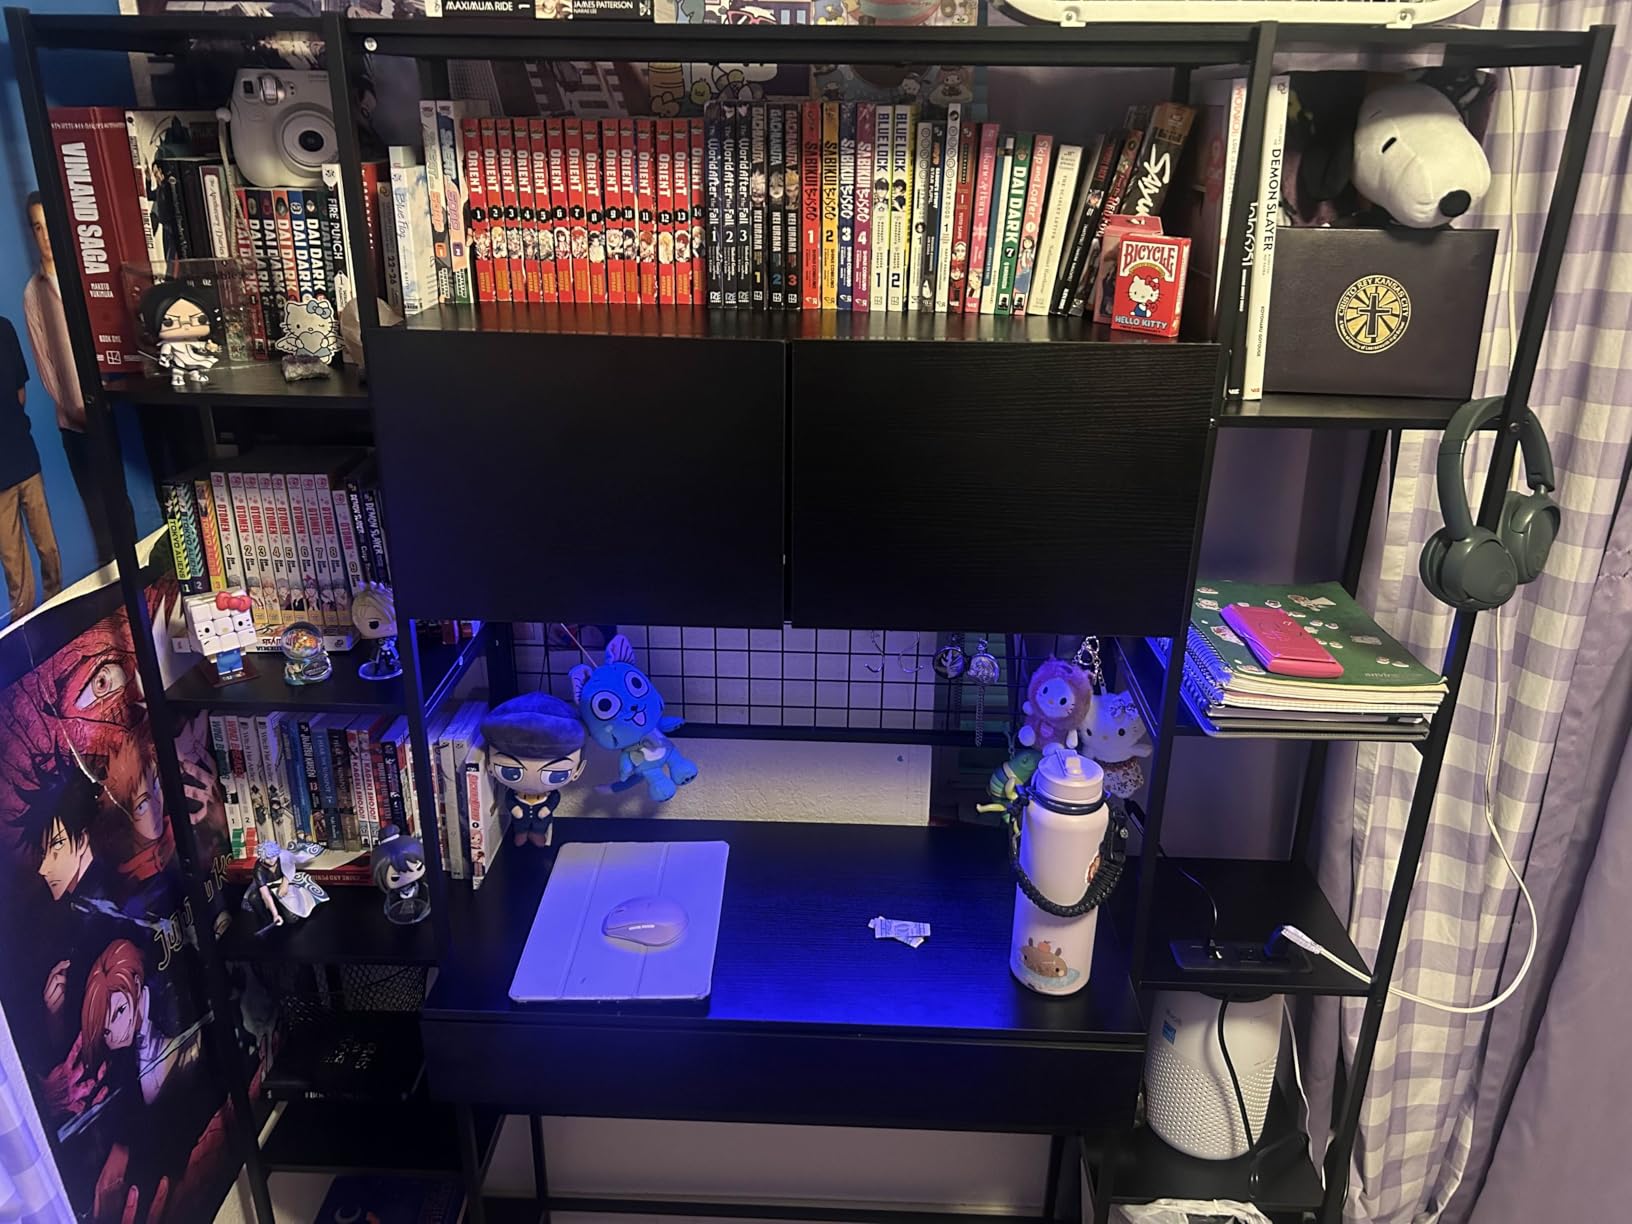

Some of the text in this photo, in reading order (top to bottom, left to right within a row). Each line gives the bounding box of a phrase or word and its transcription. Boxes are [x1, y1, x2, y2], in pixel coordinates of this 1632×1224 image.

[446, 1, 494, 11] MAXIMUM
[494, 1, 513, 10] RIDE
[574, 1, 633, 9] JAMES PATTERSON
[708, 138, 721, 169] World
[724, 139, 735, 170] World
[739, 138, 750, 169] World
[804, 141, 818, 187] SABIKUI
[823, 141, 837, 186] SABIKUI
[840, 138, 855, 185] SABIKUI
[856, 141, 871, 188] SABIKUI
[1028, 140, 1048, 218] Skip and Loafer
[61, 142, 99, 221] VINLAND
[467, 150, 482, 219] ORIENT 1
[484, 149, 499, 218] ORIENT 2
[500, 149, 515, 218] ORIENT 3
[516, 150, 530, 219] ORIENT 4
[533, 152, 547, 220] ORIENT 5
[550, 149, 564, 218] ORIENT 6
[568, 149, 582, 218] ORIENT 7
[585, 153, 599, 222] ORIENT 8
[605, 149, 618, 218] ORIENT 9
[620, 149, 633, 218] ORIENT 10
[638, 152, 650, 221] ORIENT 11
[658, 153, 670, 222] ORIENT 12
[674, 152, 687, 221] ORIENT 13
[690, 148, 703, 217] ORIENT 14
[875, 113, 892, 288] BLUE LOCK 1
[891, 113, 908, 288] BLUE LOCK 2
[1010, 166, 1027, 195] DAI
[1055, 189, 1064, 215] SCARLET
[1263, 149, 1282, 252] DEMON SLAYER
[209, 188, 225, 255] Apothecary Diaries
[249, 219, 262, 246] DAI
[263, 219, 276, 246] DAI
[327, 198, 343, 259] FIRE PUNCH
[446, 190, 461, 231] SOAP
[708, 207, 719, 225] Fall
[711, 230, 718, 242] 1
[724, 208, 736, 226] Fall
[739, 207, 750, 225] Fall
[739, 229, 747, 242] 3
[825, 230, 834, 242] 2
[842, 227, 852, 242] 3
[1005, 197, 1021, 244] DARK
[1051, 216, 1059, 239] LETTER
[76, 224, 109, 274] SAGA
[277, 219, 297, 291] DAI DARK
[292, 220, 312, 292] DAI DARK
[307, 218, 326, 291] DAI DARK
[725, 231, 734, 243] 2
[753, 210, 763, 283] KEI URANA 1
[772, 212, 781, 285] KEI URANA 2
[788, 212, 797, 286] KEI URANA 3
[807, 230, 814, 244] 1
[858, 231, 867, 245] 4
[1006, 247, 1016, 257] 7
[1123, 243, 1175, 279] BICYCLE
[1115, 315, 1168, 329] HELLO KITTY
[1339, 278, 1409, 317] CRISTO REY KANSAS CITY
[183, 518, 203, 589] TOKYO ALIENS 2
[217, 504, 232, 555] OTOMEN 1
[236, 505, 253, 556] OTOMEN 2
[251, 506, 266, 557] OTOMEN 3
[265, 507, 280, 558] OTOMEN 4
[278, 507, 293, 558] OTOMEN 5
[293, 507, 308, 557] OTOMEN 6
[308, 508, 323, 559] OTOMEN 7
[322, 507, 338, 558] OTOMEN 8
[365, 502, 383, 555] DEMON SLAYER
[171, 520, 190, 592] TOKYO ALIENS 1
[350, 562, 358, 572] 9
[213, 721, 224, 741] WIND
[228, 720, 239, 741] WIND
[300, 733, 318, 791] JUJUTSU KAISEN 13
[352, 761, 366, 819] KAGEKI SHOJO!!
[363, 763, 377, 820] KAGEKI SHOJO!!
